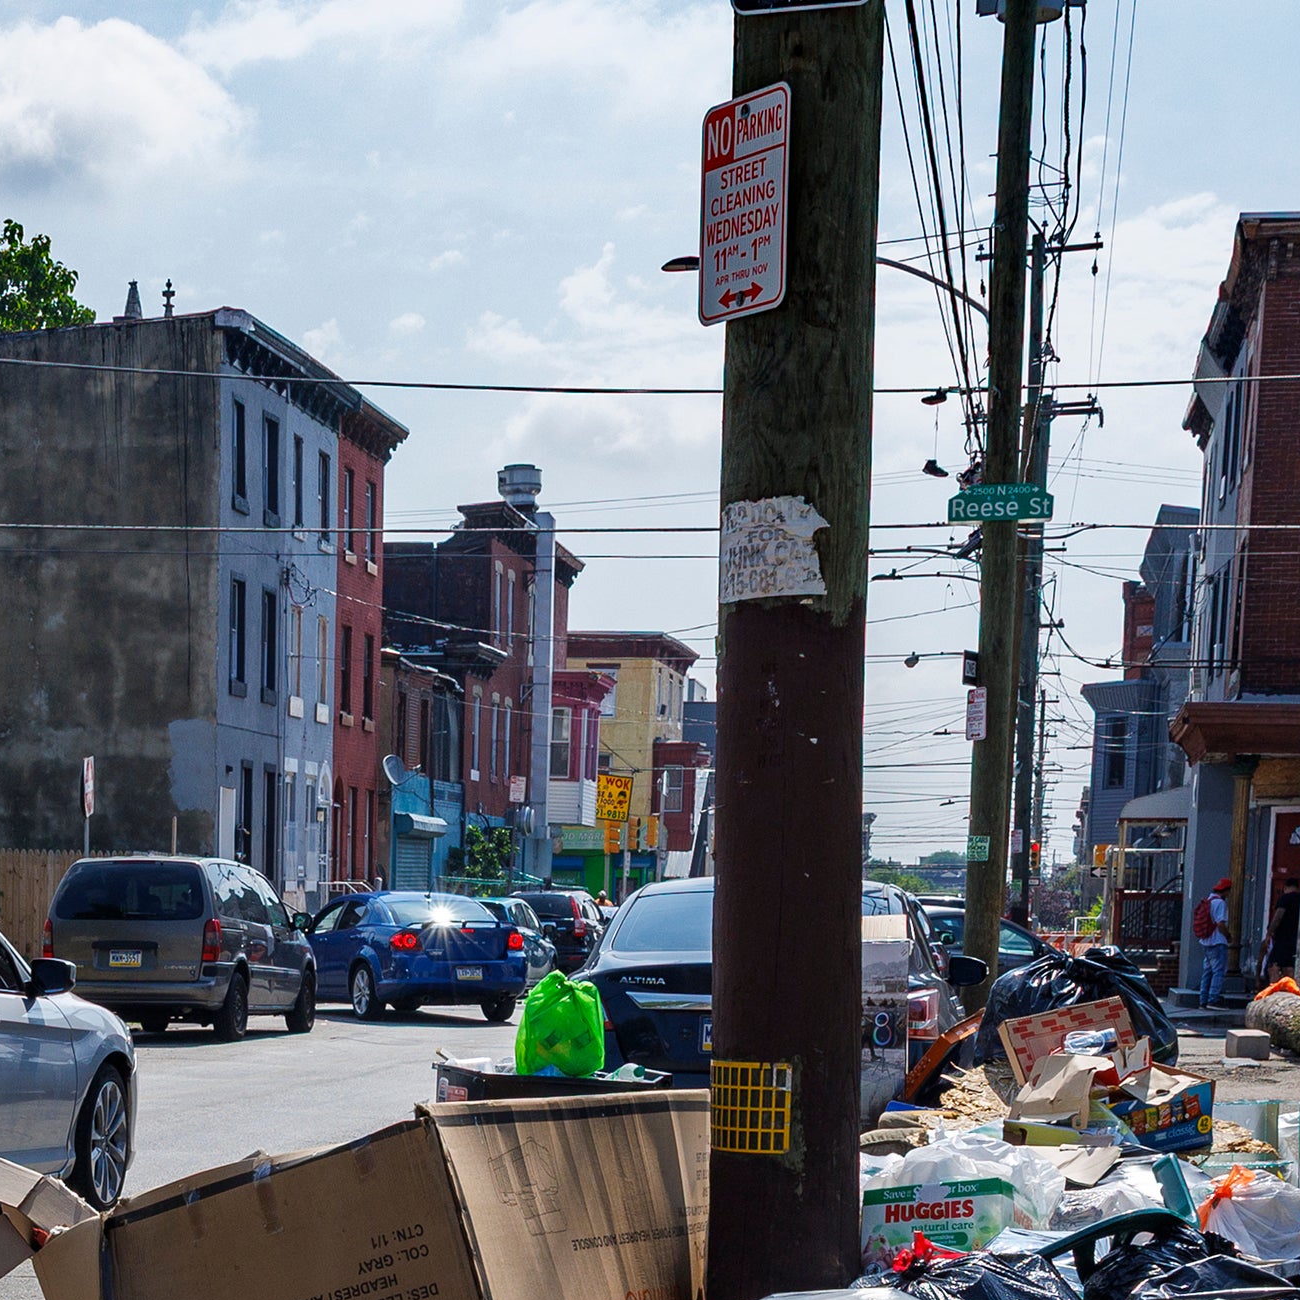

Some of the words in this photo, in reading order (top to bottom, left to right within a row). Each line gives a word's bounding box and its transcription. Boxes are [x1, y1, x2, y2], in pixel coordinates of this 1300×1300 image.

[707, 116, 732, 161] NO
[736, 103, 782, 145] PARKING
[720, 157, 767, 190] STREET
[711, 179, 775, 217] CLEANING
[706, 202, 779, 247] WEDNESDAY
[715, 272, 730, 287] APR
[731, 267, 750, 282] THRU
[752, 263, 769, 276] NOV
[973, 486, 995, 496] 2500
[996, 484, 1006, 497] N
[1008, 485, 1031, 495] 2400
[951, 500, 1019, 519] Reese
[1029, 499, 1050, 516] St
[606, 777, 630, 791] WOK
[619, 976, 666, 985] ALTIMA
[883, 1190, 905, 1200] Save
[958, 1183, 977, 1193] box
[885, 1199, 974, 1223] HUGGIES
[391, 1223, 424, 1241] CTN:
[911, 1222, 949, 1233] natural
[951, 1221, 974, 1231] care
[370, 1233, 389, 1250] 1/1
[397, 1244, 429, 1262] COL:
[357, 1254, 394, 1275] GRAY
